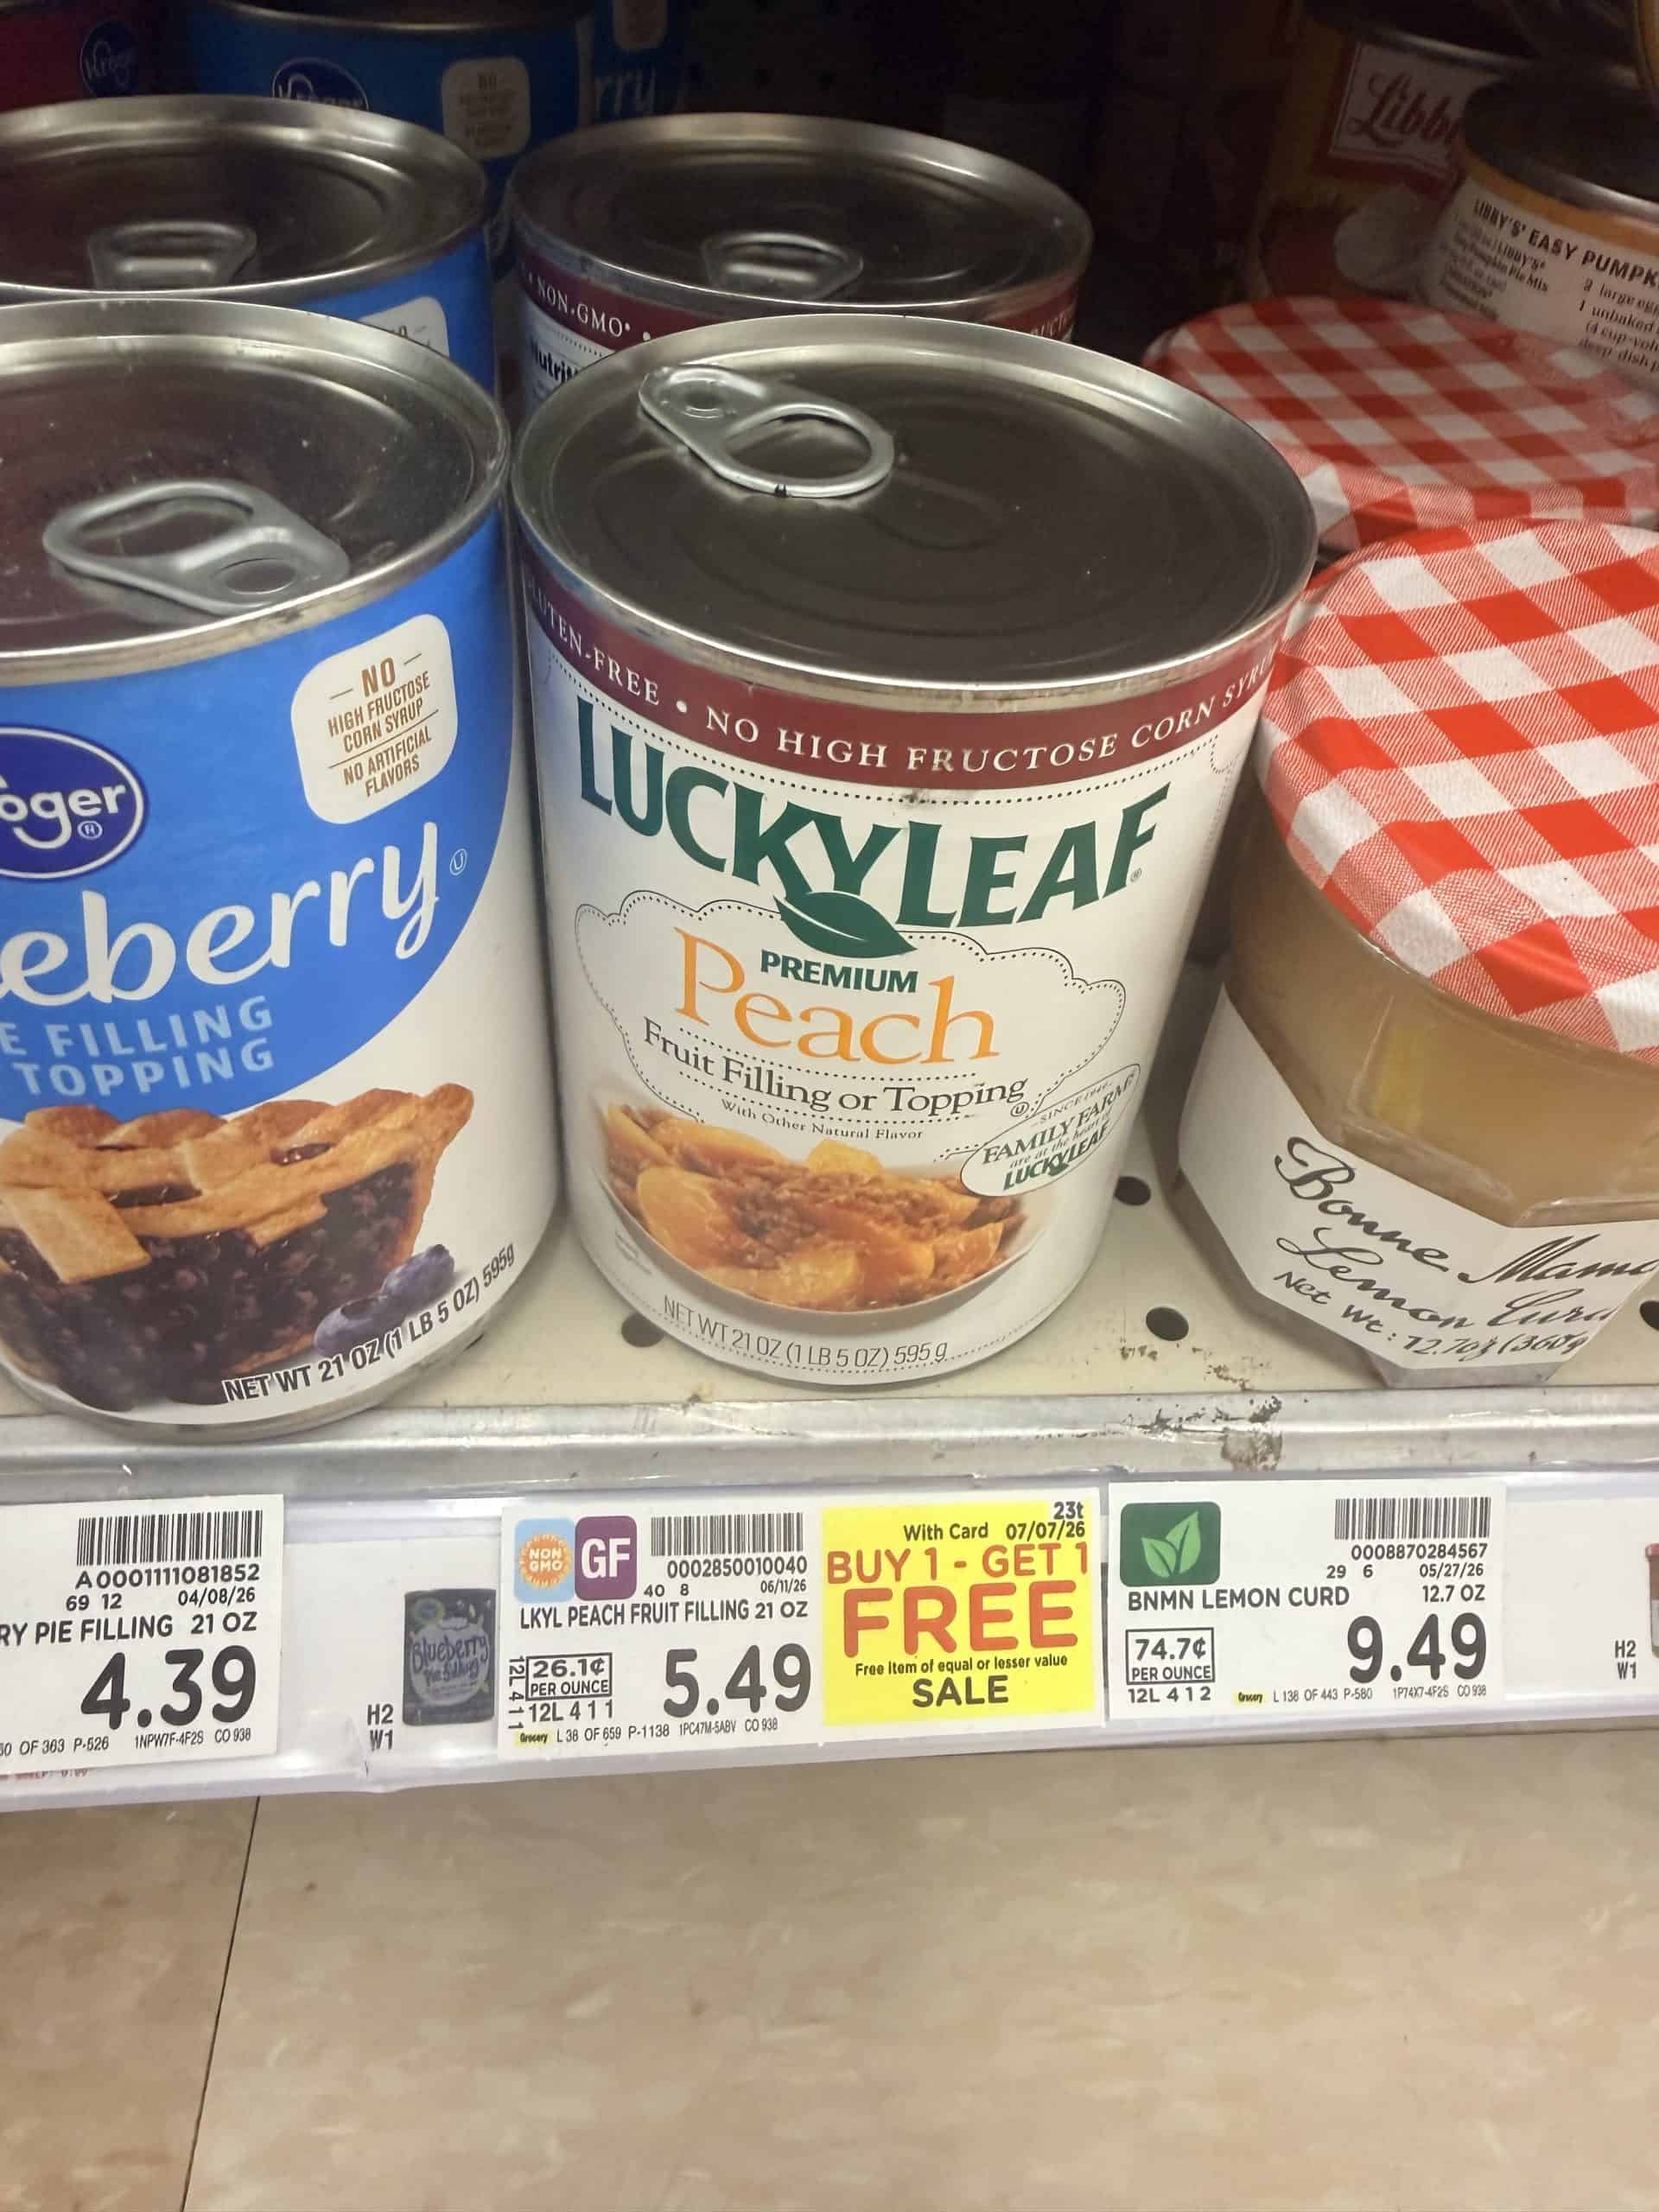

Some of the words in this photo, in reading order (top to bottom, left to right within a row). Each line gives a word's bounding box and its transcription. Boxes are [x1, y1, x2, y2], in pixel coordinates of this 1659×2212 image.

[1529, 229, 1579, 260] EASY
[1581, 249, 1659, 289] PUMPK
[361, 657, 397, 697] NO
[327, 706, 364, 737] HIGH
[367, 671, 431, 720] FRUCTOSE
[343, 721, 382, 753] CORN
[385, 697, 423, 733] SYRUP
[705, 704, 760, 745] NO
[777, 728, 887, 770] HIGH
[906, 735, 1118, 773] FRUCTOSE
[1131, 695, 1216, 748] CORN
[343, 762, 364, 785] NO
[368, 726, 433, 776] ARTIFICIAL
[365, 755, 420, 798] FLAVORS
[0, 772, 126, 849] oger
[760, 950, 918, 995] PREMIUM
[674, 925, 1001, 1067] Peach
[44, 995, 274, 1058] FILLING
[12, 1038, 275, 1096] TOPPING
[643, 1016, 715, 1077] Fruit
[721, 1055, 832, 1113] Filling
[838, 1090, 877, 1112] or
[883, 1077, 1030, 1119] Topping
[720, 1097, 757, 1121] With
[761, 1112, 807, 1133] Other
[810, 1122, 871, 1140] Natural
[874, 1126, 925, 1140] Flavor
[982, 1116, 1075, 1165] FAMILY
[1274, 1136, 1451, 1273] Bonne
[1273, 1271, 1332, 1305] Net
[1276, 1227, 1473, 1328] Lemon
[223, 1375, 271, 1403] NET
[273, 1364, 312, 1393] WT
[318, 1354, 345, 1383] 21
[351, 1338, 381, 1370] OZ
[385, 1327, 404, 1357] (1
[409, 1312, 434, 1342] LB
[437, 1300, 450, 1324] 5
[453, 1277, 480, 1313] OZ)
[482, 1243, 515, 1288] 595g
[698, 1313, 729, 1343] WT
[732, 1328, 753, 1351] 21
[757, 1335, 782, 1359] OZ
[785, 1342, 802, 1364] (1
[808, 1345, 832, 1366] LB
[836, 1348, 849, 1367] 5
[854, 1344, 889, 1370] OZ)
[893, 1342, 930, 1365] 595
[1053, 1501, 1084, 1520] 23t
[903, 1523, 944, 1541] With
[950, 1522, 989, 1540] Card
[1005, 1520, 1086, 1541] 07/07/26
[529, 1547, 563, 1559] NON
[529, 1560, 563, 1572] GMO
[581, 1537, 632, 1579] GF
[666, 1556, 808, 1579] 0002850010040
[827, 1548, 912, 1585] BUY
[924, 1547, 938, 1581] 1
[982, 1542, 1062, 1579] GET
[1074, 1541, 1088, 1575] 1
[1351, 1543, 1488, 1560] 0008870284567
[1325, 1564, 1347, 1580] 29
[1362, 1564, 1374, 1579] 6
[1419, 1562, 1484, 1580] 05/27/26
[66, 1595, 90, 1611] 69
[101, 1593, 123, 1610] 12
[178, 1586, 256, 1607] 04/08/26
[644, 1583, 665, 1598] 40
[679, 1582, 690, 1597] 8
[760, 1579, 807, 1594] 06/11/26
[1128, 1589, 1194, 1611] BNMN
[1201, 1587, 1281, 1610] LEMON
[1288, 1586, 1350, 1607] CURD
[1422, 1585, 1455, 1603] 12.7
[1459, 1583, 1486, 1602] OZ
[35, 1620, 73, 1644] PIE
[80, 1614, 174, 1642] FILLING
[190, 1613, 214, 1635] 21
[222, 1611, 258, 1633] OZ
[520, 1606, 563, 1630] LKYL
[568, 1604, 625, 1628] PEACH
[630, 1601, 679, 1625] FRUIT
[684, 1599, 750, 1624] FILLING
[754, 1602, 774, 1619] 21
[779, 1600, 809, 1618] OZ
[843, 1580, 1079, 1658] FREE
[413, 1632, 489, 1674] Blueberry
[1135, 1637, 1206, 1661] 74.7¢
[1347, 1611, 1487, 1684] 9.49
[1614, 1639, 1637, 1658] H2
[531, 1657, 605, 1679] 26.1¢
[664, 1643, 812, 1718] 5.49
[855, 1662, 885, 1677] Free
[920, 1659, 934, 1673] of
[938, 1657, 973, 1674] equal
[976, 1660, 991, 1672] or
[994, 1656, 1030, 1671] lesser
[1034, 1654, 1068, 1668] value
[1131, 1666, 1158, 1681] PER
[1162, 1665, 1211, 1680] OUNCE
[1617, 1661, 1637, 1680] W1
[80, 1645, 257, 1730] 4.39
[530, 1682, 556, 1697] PER
[560, 1679, 609, 1695] OUNCE
[912, 1675, 1009, 1708] SALE
[1128, 1688, 1160, 1703] 12L
[1166, 1687, 1179, 1702] 4
[1185, 1687, 1194, 1701] 1
[1199, 1686, 1211, 1701] 2
[1283, 1689, 1300, 1702] 138
[1304, 1688, 1318, 1701] OF
[1321, 1688, 1338, 1700] 443
[1344, 1687, 1373, 1700] P-580
[367, 1703, 394, 1726] H2
[528, 1701, 564, 1723] 12L
[569, 1700, 582, 1720] 4
[587, 1699, 596, 1719] 1
[605, 1699, 613, 1719] 1
[19, 1740, 39, 1756] OF
[214, 1729, 231, 1744] CO
[370, 1729, 393, 1751] W1
[566, 1729, 579, 1742] 38
[584, 1728, 600, 1741] OF
[603, 1726, 622, 1740] 659
[628, 1724, 671, 1738] P-1138
[745, 1718, 760, 1732] CO
[761, 1716, 779, 1730] 938
